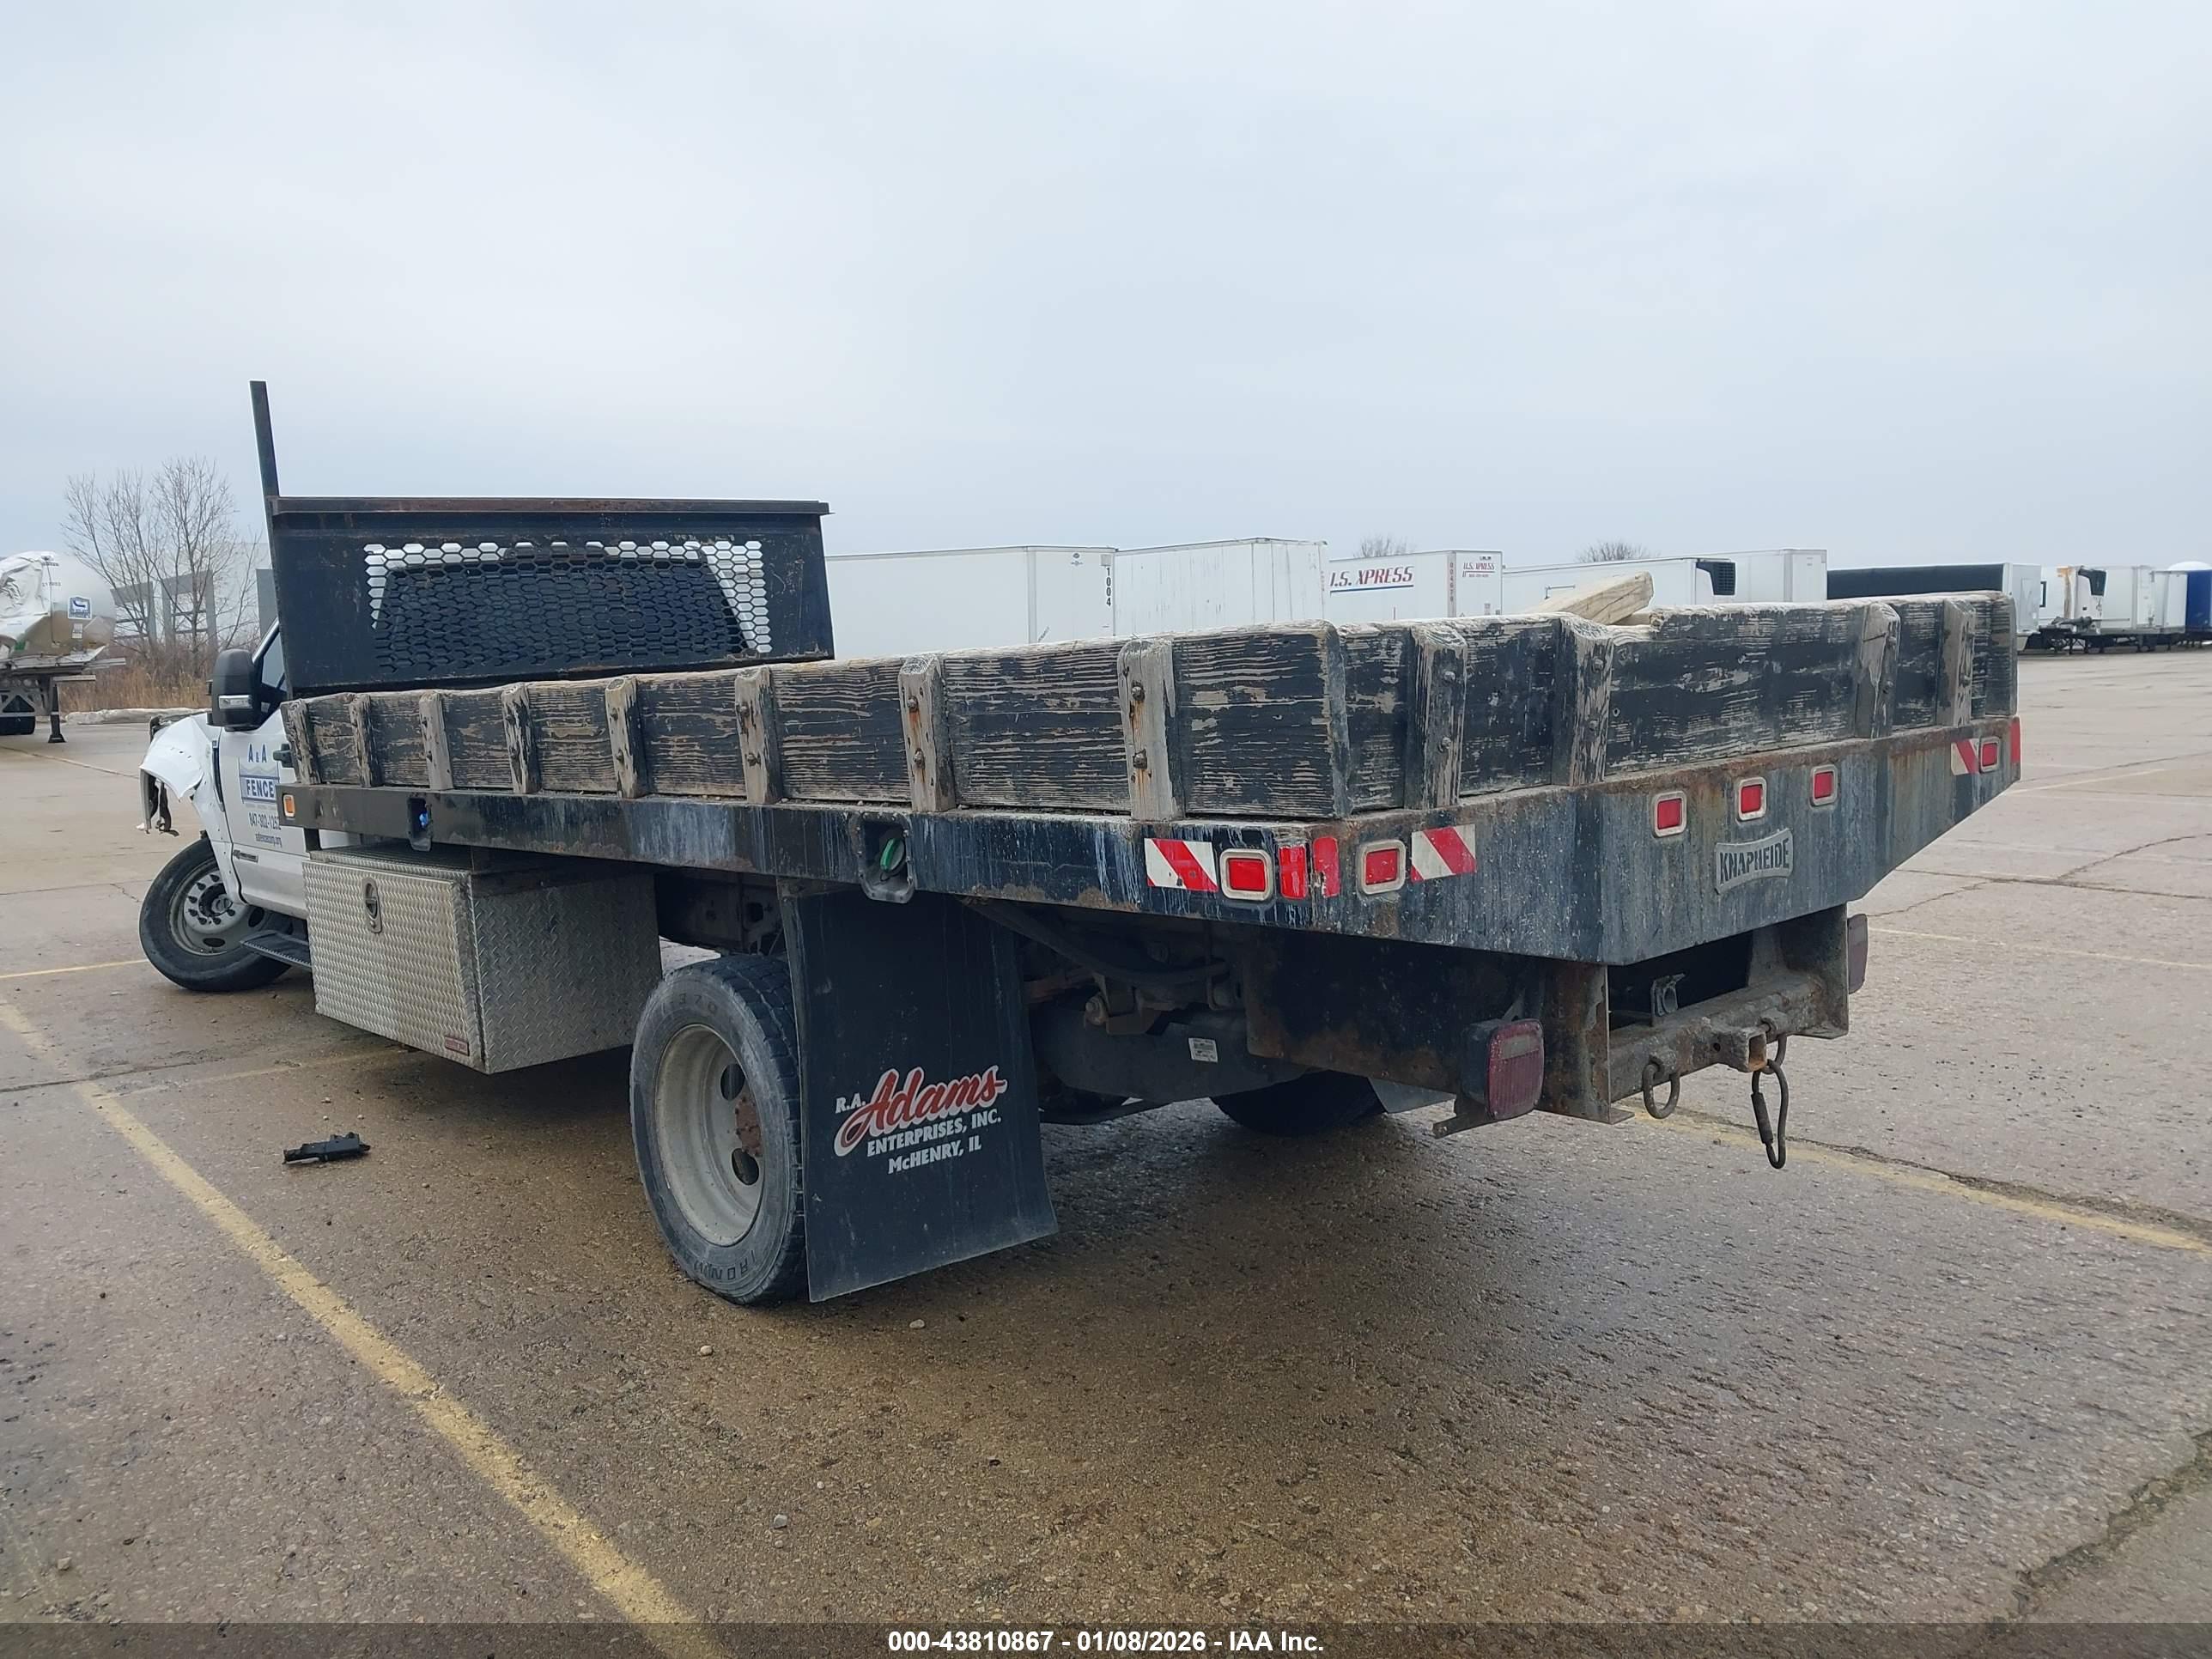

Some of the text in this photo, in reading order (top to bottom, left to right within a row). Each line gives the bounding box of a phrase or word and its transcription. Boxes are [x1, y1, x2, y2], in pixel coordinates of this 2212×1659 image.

[1357, 566, 1414, 585] XPRESS
[248, 743, 254, 763] A
[261, 744, 267, 763] A
[246, 779, 275, 799] FENCE
[1719, 838, 1790, 884] KNAPHEIDE
[834, 1065, 1008, 1157] R.A. Adams
[866, 1109, 1002, 1158] ENTERPRISES, INC.
[888, 1134, 982, 1175] McHENRY, IL
